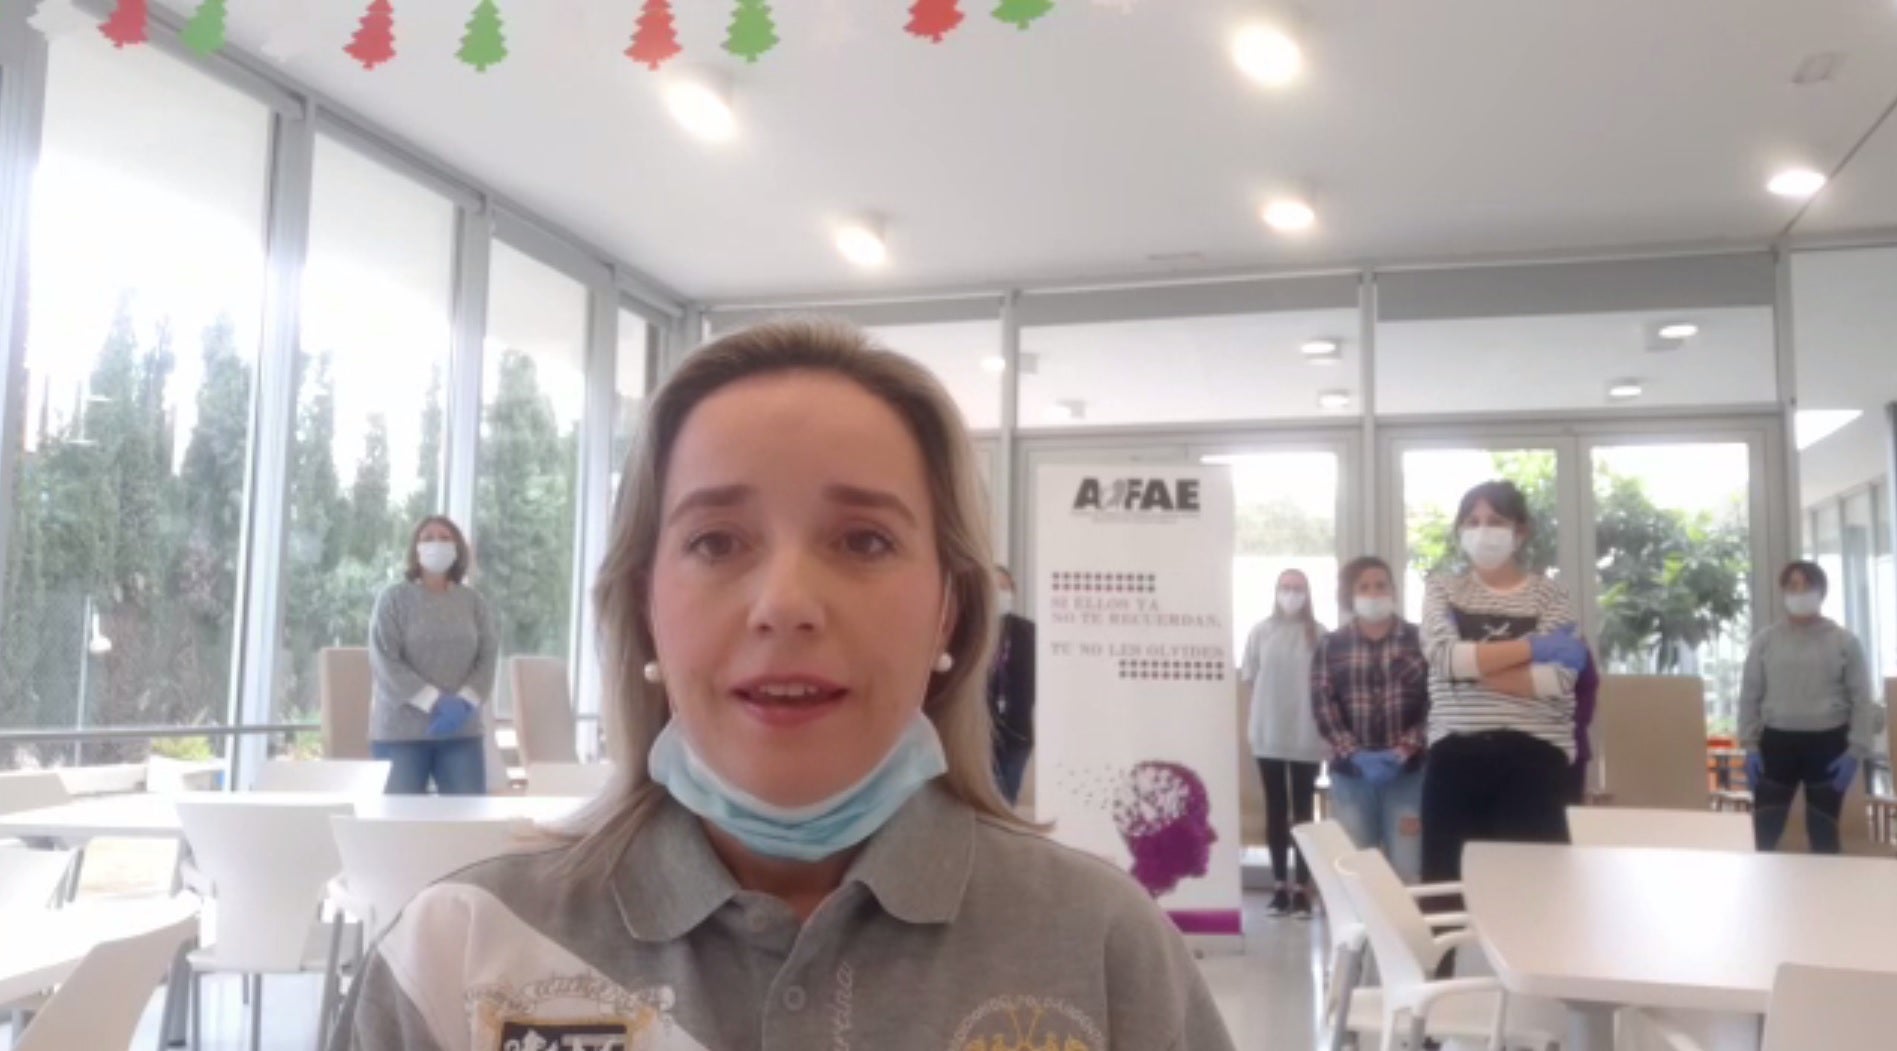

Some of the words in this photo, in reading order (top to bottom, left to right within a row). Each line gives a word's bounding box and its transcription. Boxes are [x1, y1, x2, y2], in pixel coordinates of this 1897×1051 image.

[1073, 597, 1130, 611] ELLOS
[1136, 598, 1159, 612] YA
[1051, 613, 1075, 625] NO
[1081, 613, 1104, 625] TE
[1079, 642, 1103, 656] NO
